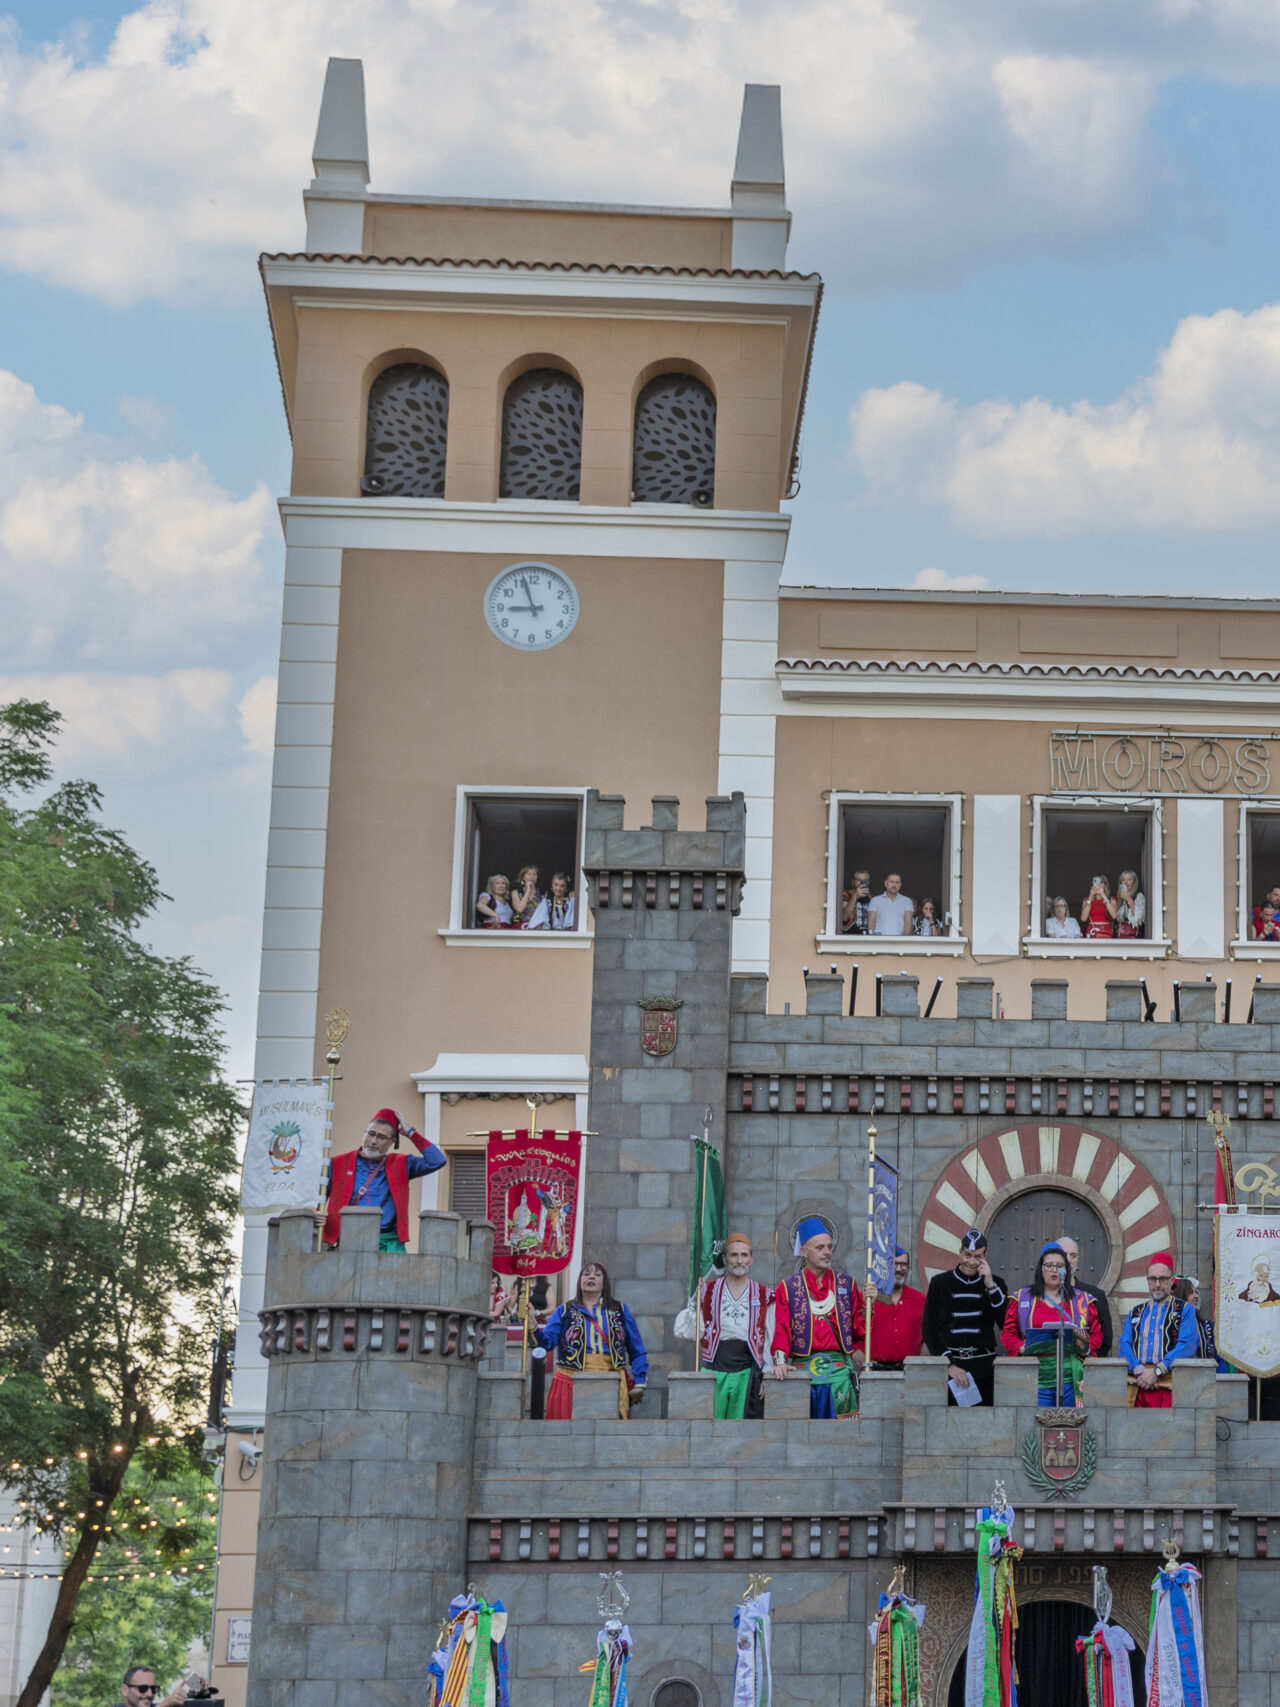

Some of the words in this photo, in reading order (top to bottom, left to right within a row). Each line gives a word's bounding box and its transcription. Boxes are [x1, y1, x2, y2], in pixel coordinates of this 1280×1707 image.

[528, 575, 540, 585] 12
[547, 580, 552, 590] 1
[503, 588, 514, 598] 10
[556, 590, 564, 600] 2
[496, 603, 505, 613] 9
[562, 604, 569, 615] 3
[501, 617, 509, 628] 8
[556, 619, 564, 629] 4
[512, 628, 519, 639] 7
[527, 633, 536, 643] 6
[544, 629, 552, 639] 5
[1050, 737, 1270, 796] MOROS
[260, 1100, 322, 1118] MUSULMANES
[264, 1181, 296, 1194] ELDA
